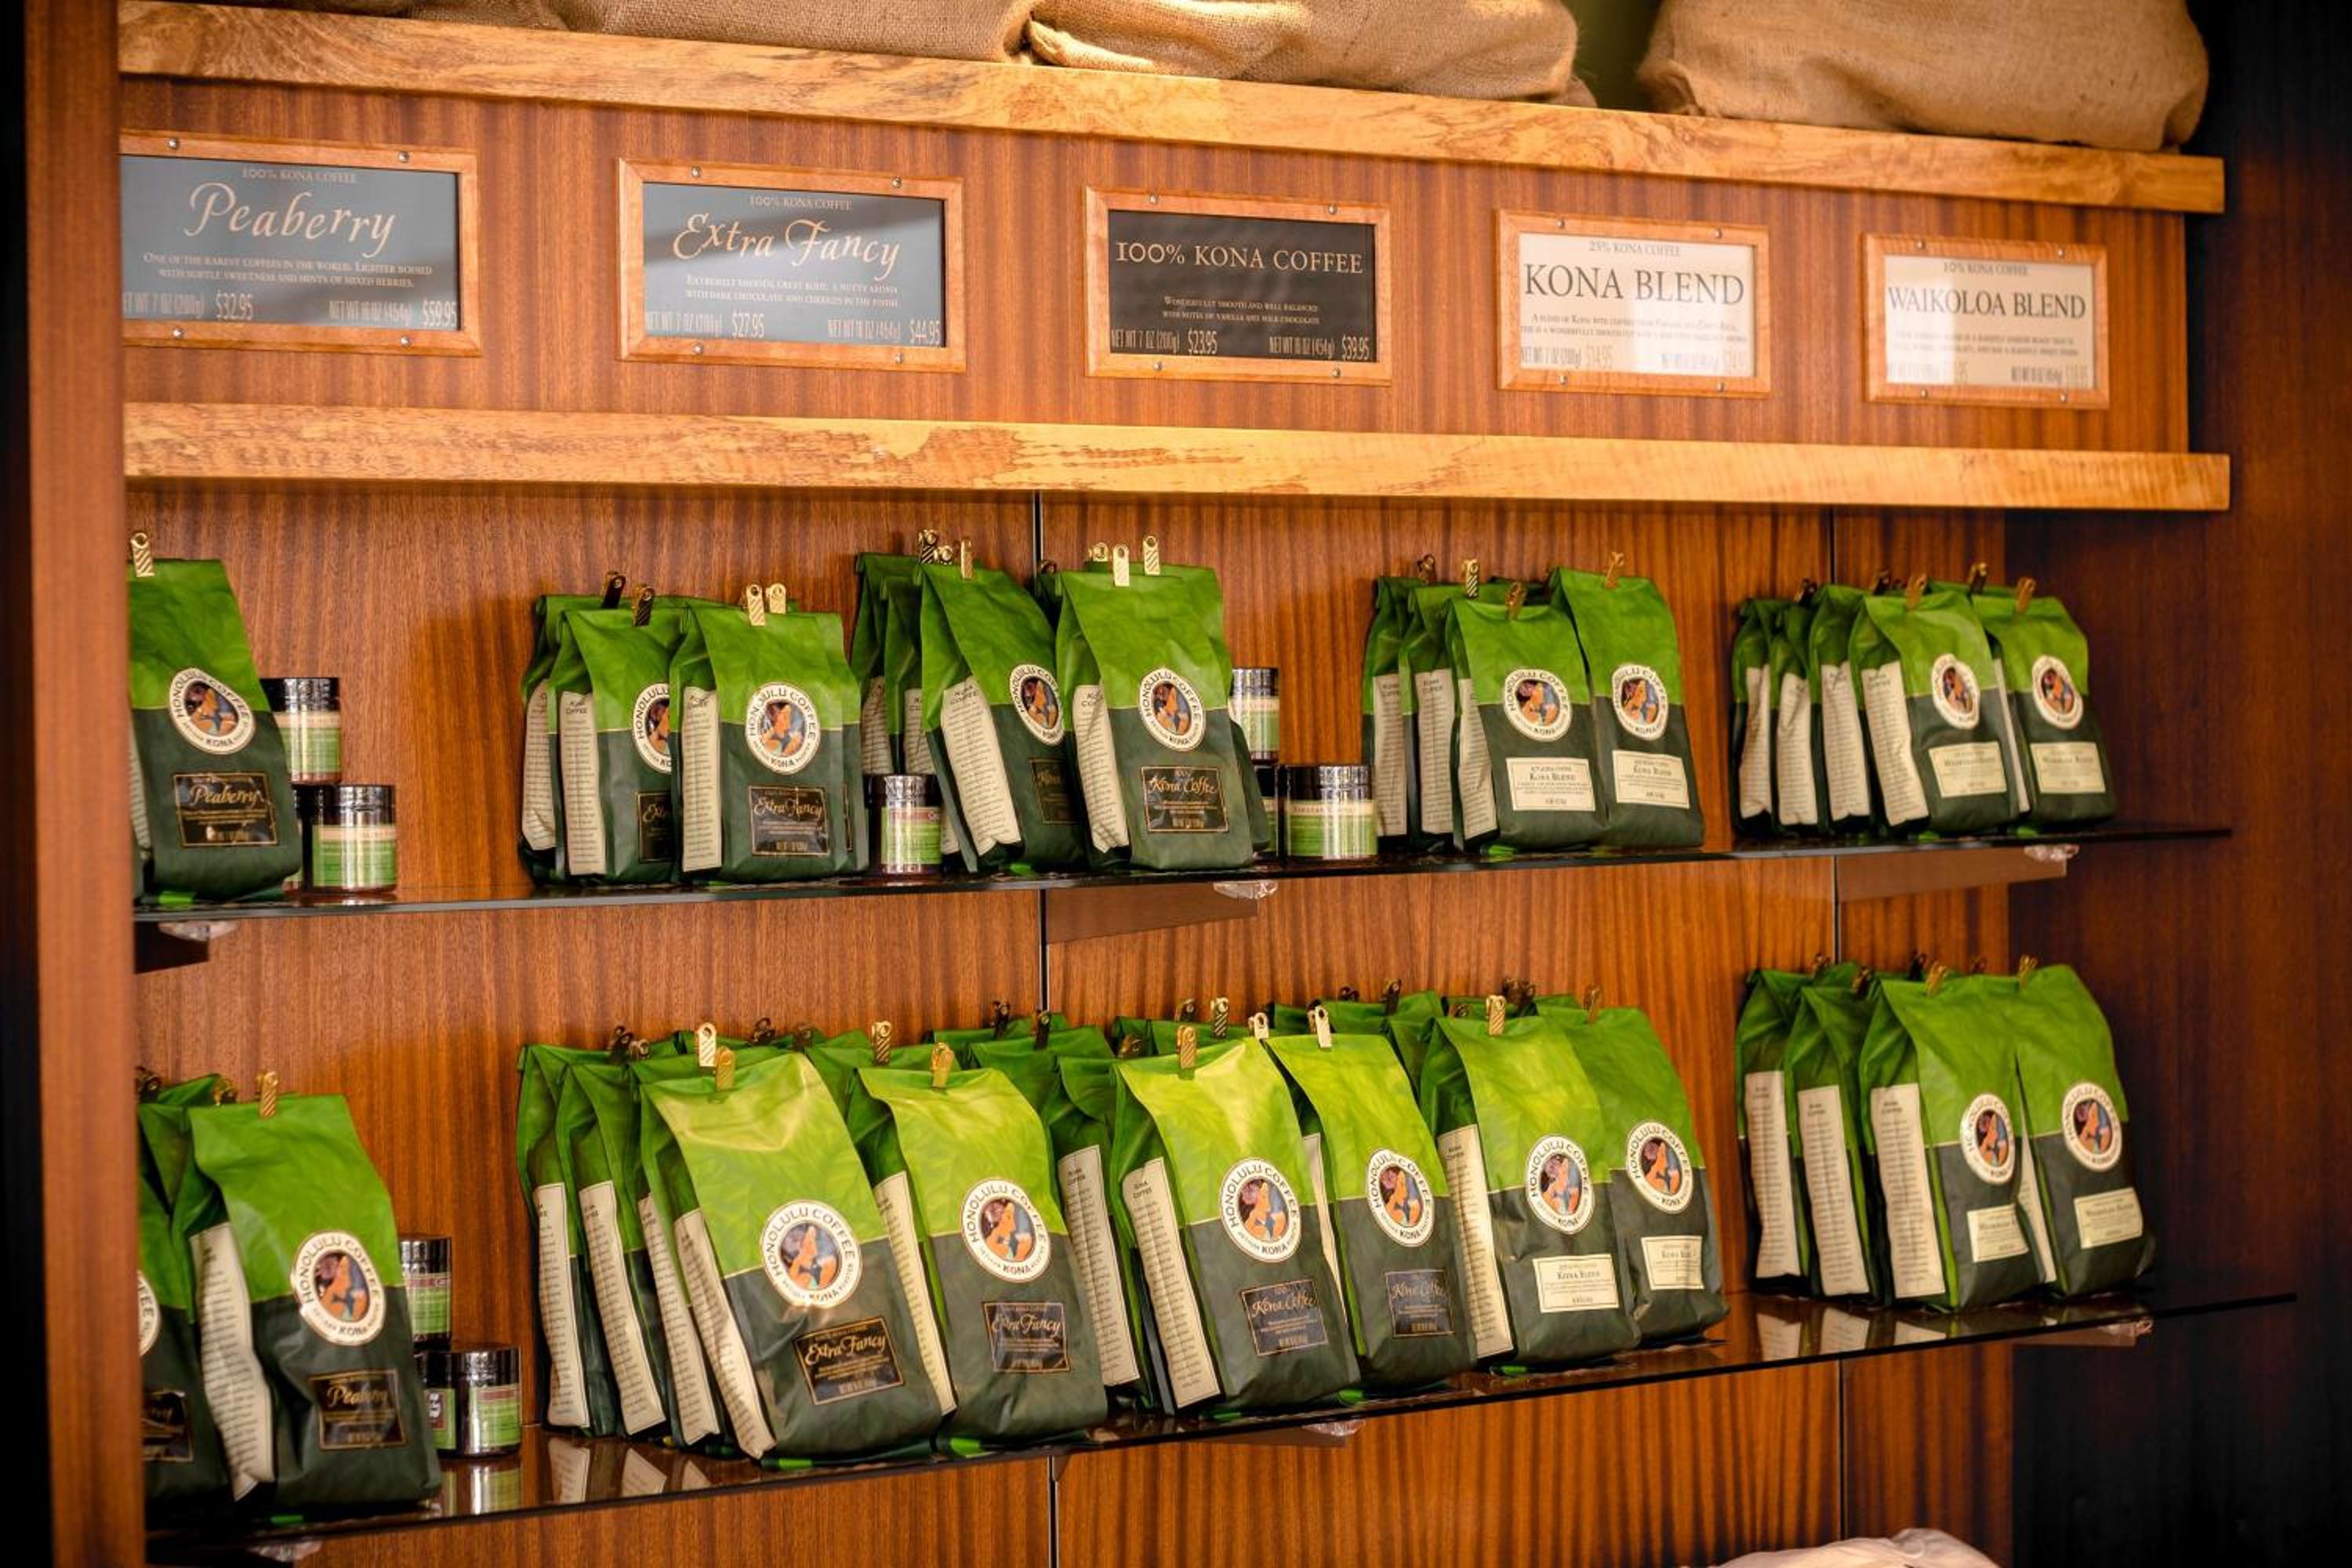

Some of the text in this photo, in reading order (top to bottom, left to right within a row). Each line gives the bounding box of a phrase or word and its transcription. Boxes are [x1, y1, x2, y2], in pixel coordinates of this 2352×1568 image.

[183, 181, 396, 260] Peaberry
[673, 212, 901, 281] Extra Fancy
[1116, 242, 1363, 274] 100% KONA COFFEE
[1613, 242, 1643, 255] KONA
[1523, 263, 1745, 306] KONA BLEND
[215, 289, 253, 321] $32.95
[422, 298, 457, 328] $59.95
[1888, 287, 2086, 319] WAIKOLOA BLEND
[731, 307, 765, 339] $27.95
[909, 318, 941, 345] $44.95
[1188, 326, 1218, 355] $23.95
[1341, 333, 1370, 361] $39.95
[789, 691, 816, 740] COFFEE
[189, 782, 259, 808] Peaberry
[1529, 1140, 1566, 1197] HONOLULU
[1629, 1125, 1660, 1180] HONOLULU
[1225, 1164, 1298, 1228] HONOLULU COFFEE
[1370, 1152, 1430, 1209] HONOLULU COFFEE
[967, 1185, 1047, 1243] HONOLULU COFFEE
[768, 1207, 855, 1276] HONOLULU COFFEE
[1261, 1244, 1288, 1254] KONA
[1399, 1229, 1421, 1239] KONA
[304, 1236, 341, 1304] HONOLULU
[1019, 1314, 1062, 1338] Fancy
[805, 1335, 886, 1366] Extra Fancy
